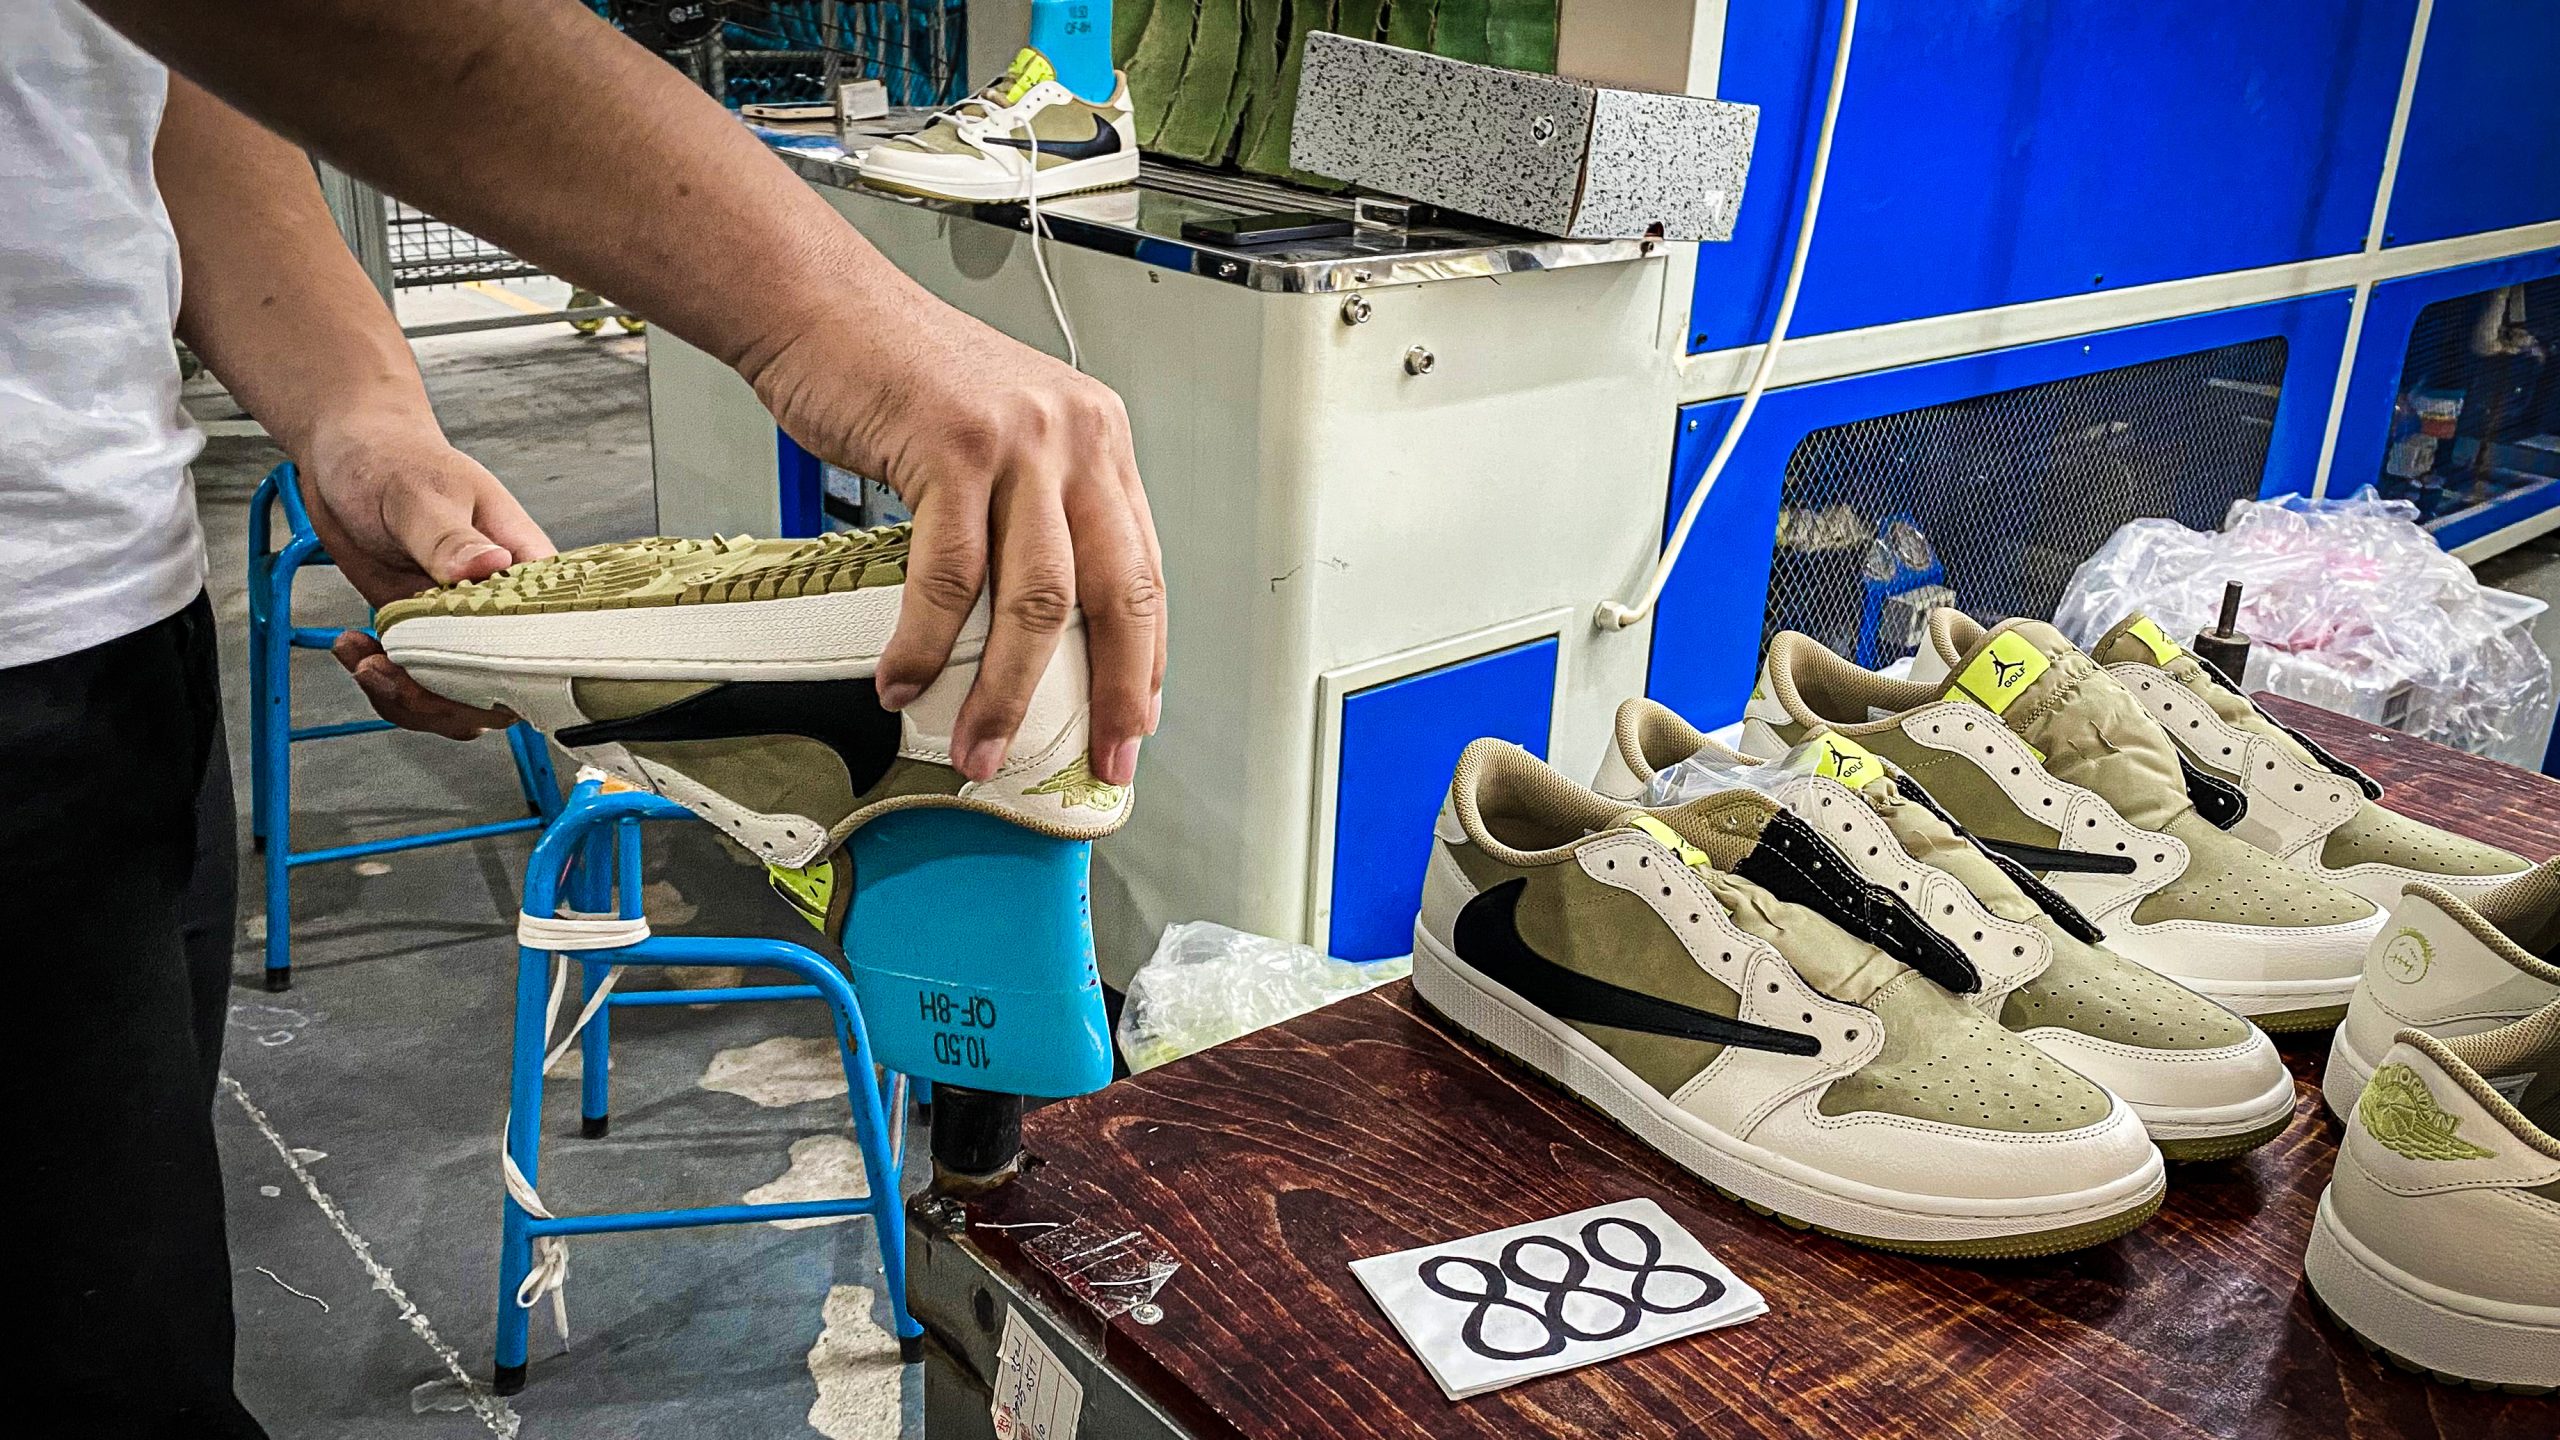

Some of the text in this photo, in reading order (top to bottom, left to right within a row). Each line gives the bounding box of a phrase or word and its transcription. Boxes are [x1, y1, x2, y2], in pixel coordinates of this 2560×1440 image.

[2004, 667, 2026, 688] GOLF
[1843, 761, 1864, 778] GOLF
[919, 991, 997, 1029] QF-8H
[933, 1031, 990, 1069] 10.5D
[1418, 1216, 1726, 1361] 888
